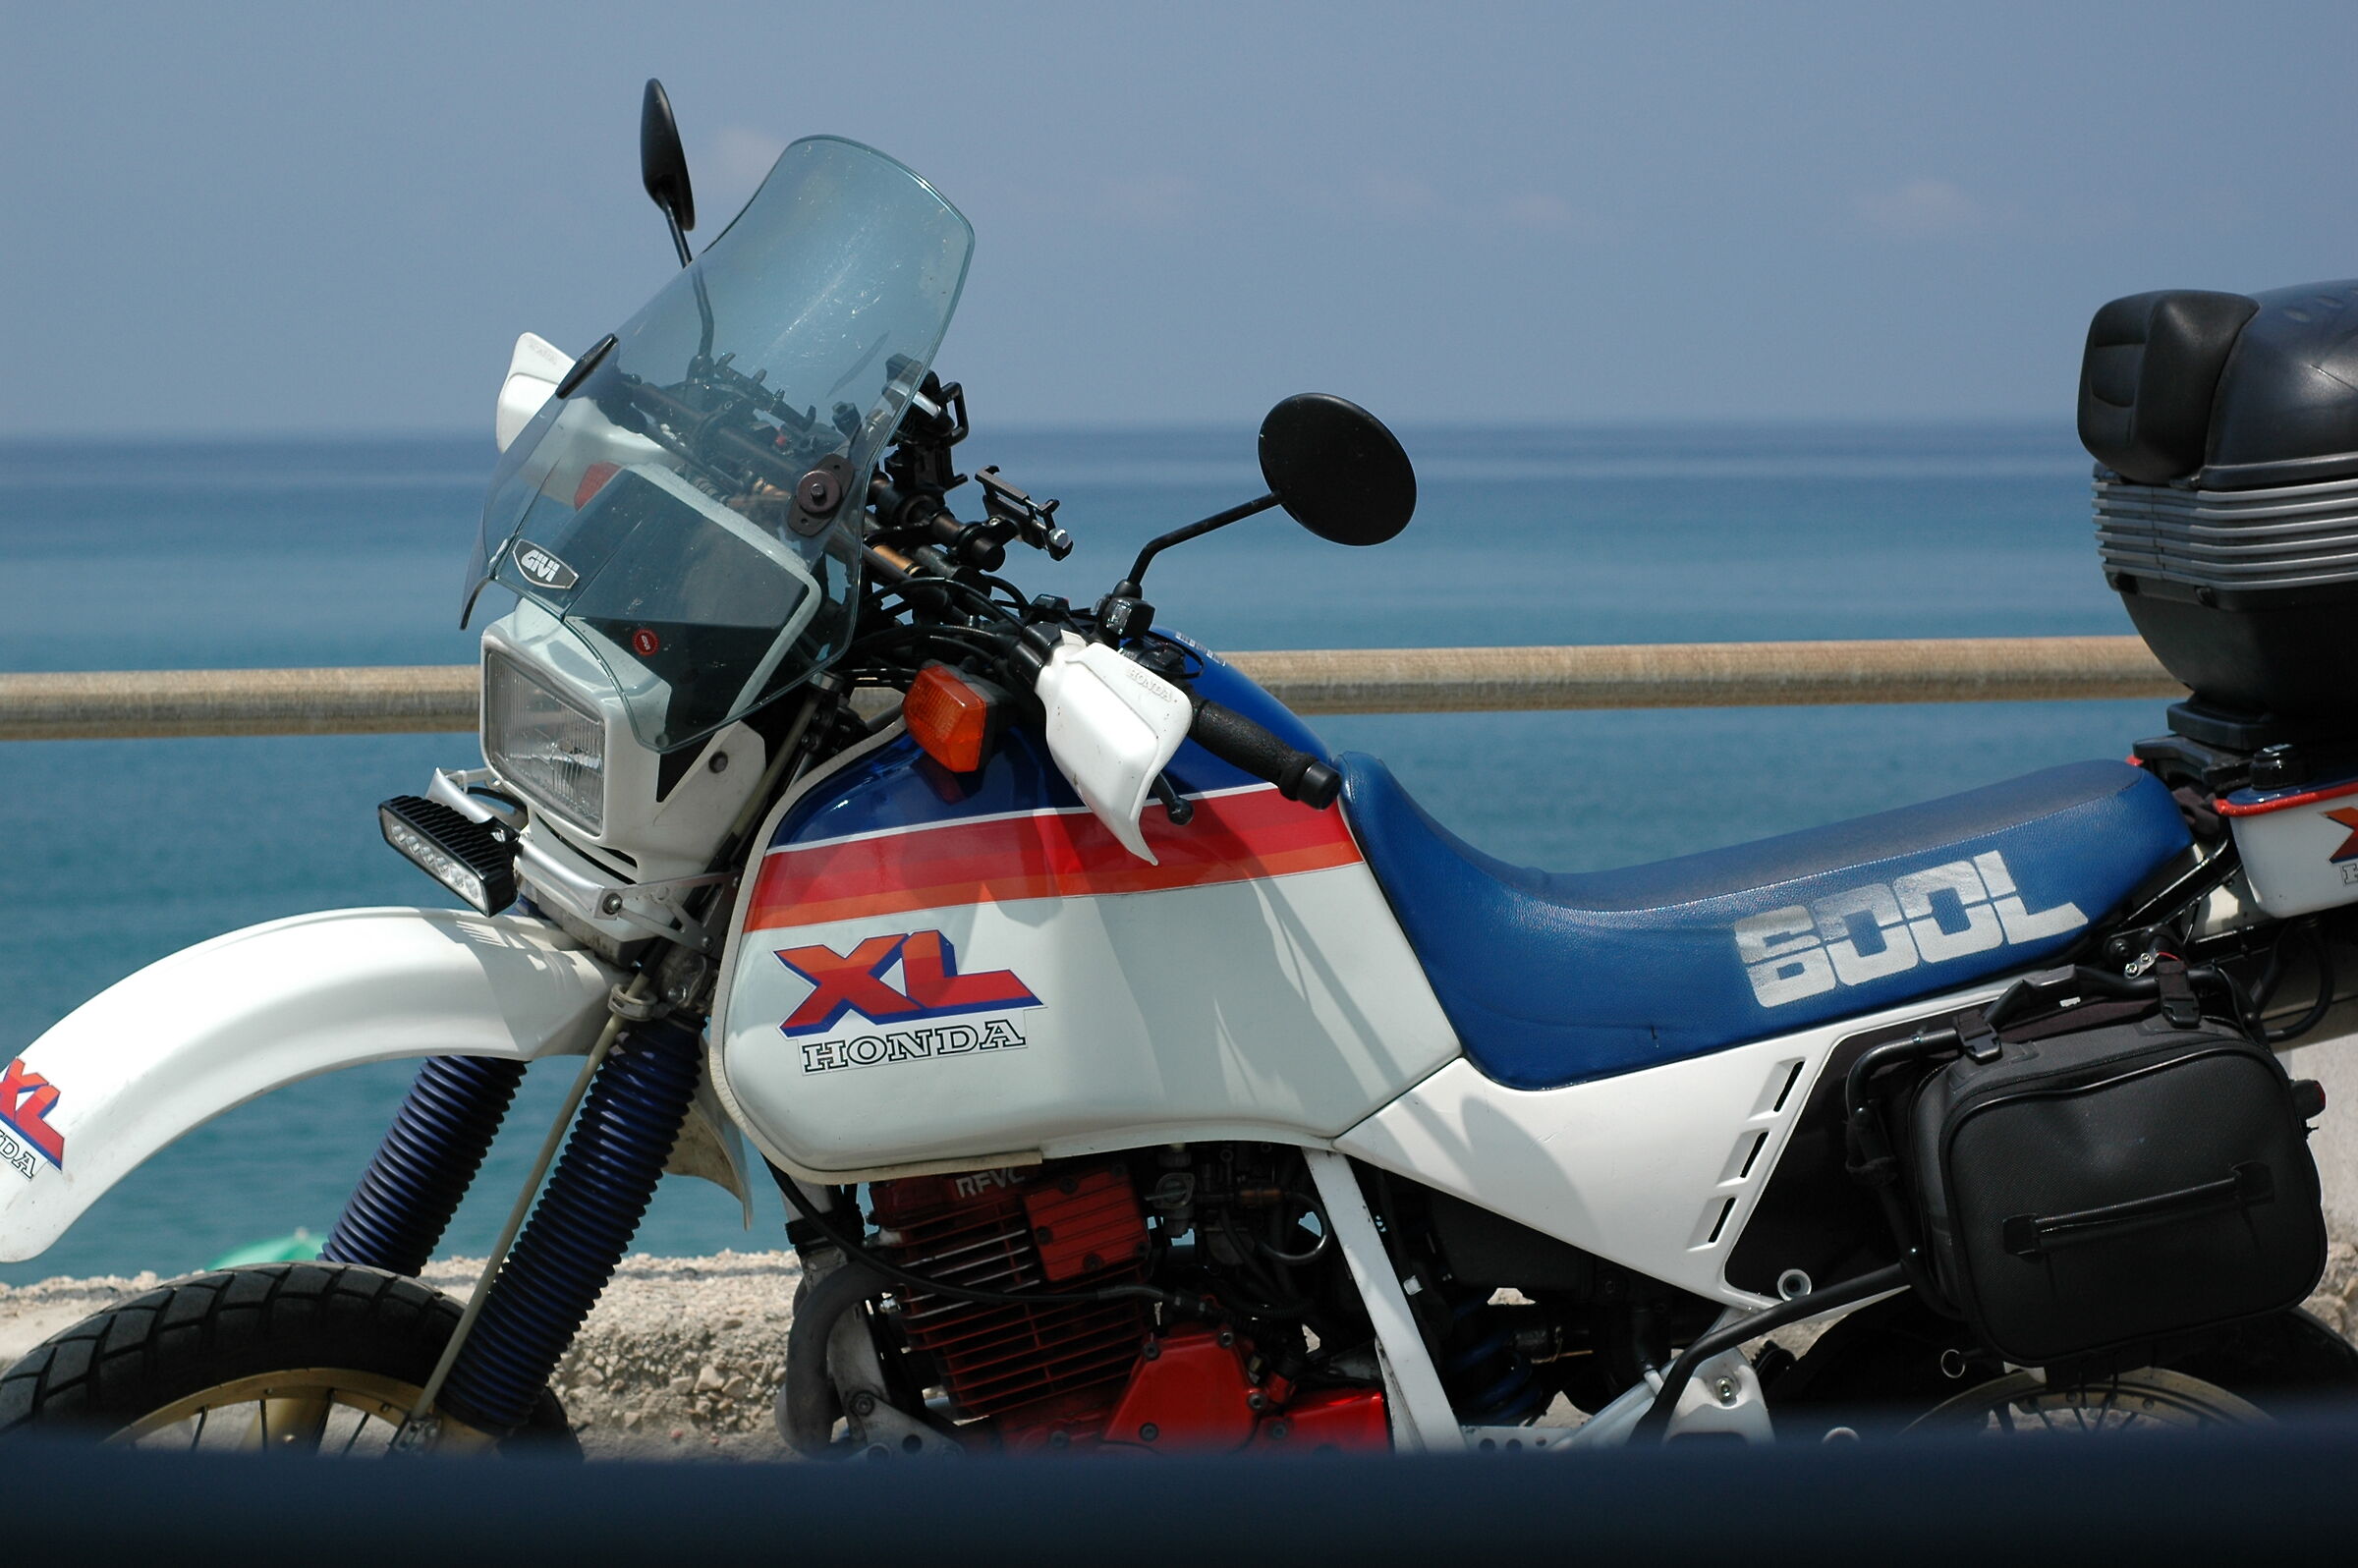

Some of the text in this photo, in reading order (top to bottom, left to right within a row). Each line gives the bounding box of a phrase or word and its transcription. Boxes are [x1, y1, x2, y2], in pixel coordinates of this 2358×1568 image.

[521, 549, 560, 583] GIVI
[1126, 667, 1172, 702] HONDA
[1734, 850, 2089, 1008] 600L
[773, 929, 1043, 1037] XL
[802, 1019, 1026, 1073] HONDA
[955, 1167, 1026, 1198] RFVC
